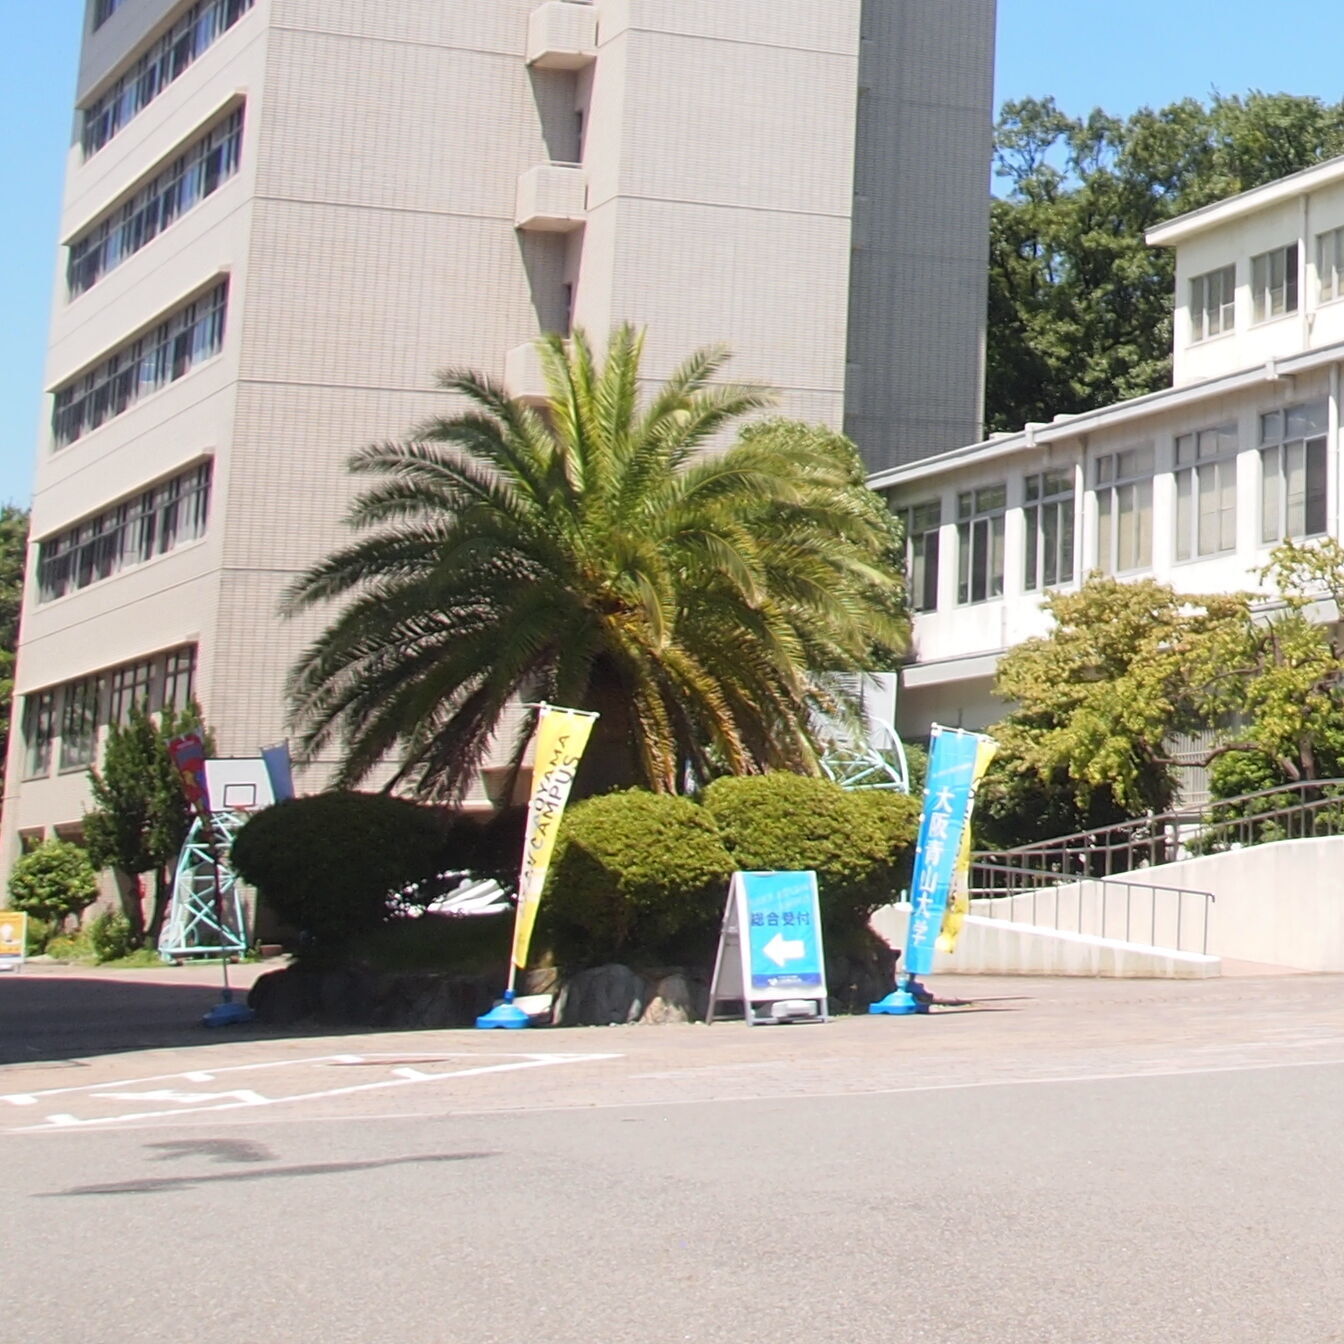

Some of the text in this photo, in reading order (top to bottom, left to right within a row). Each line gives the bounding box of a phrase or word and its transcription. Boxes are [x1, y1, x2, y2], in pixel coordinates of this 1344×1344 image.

[529, 754, 580, 850] CAMPUS
[911, 786, 956, 946] 大阪青山大学
[750, 910, 810, 927] 総合受付
